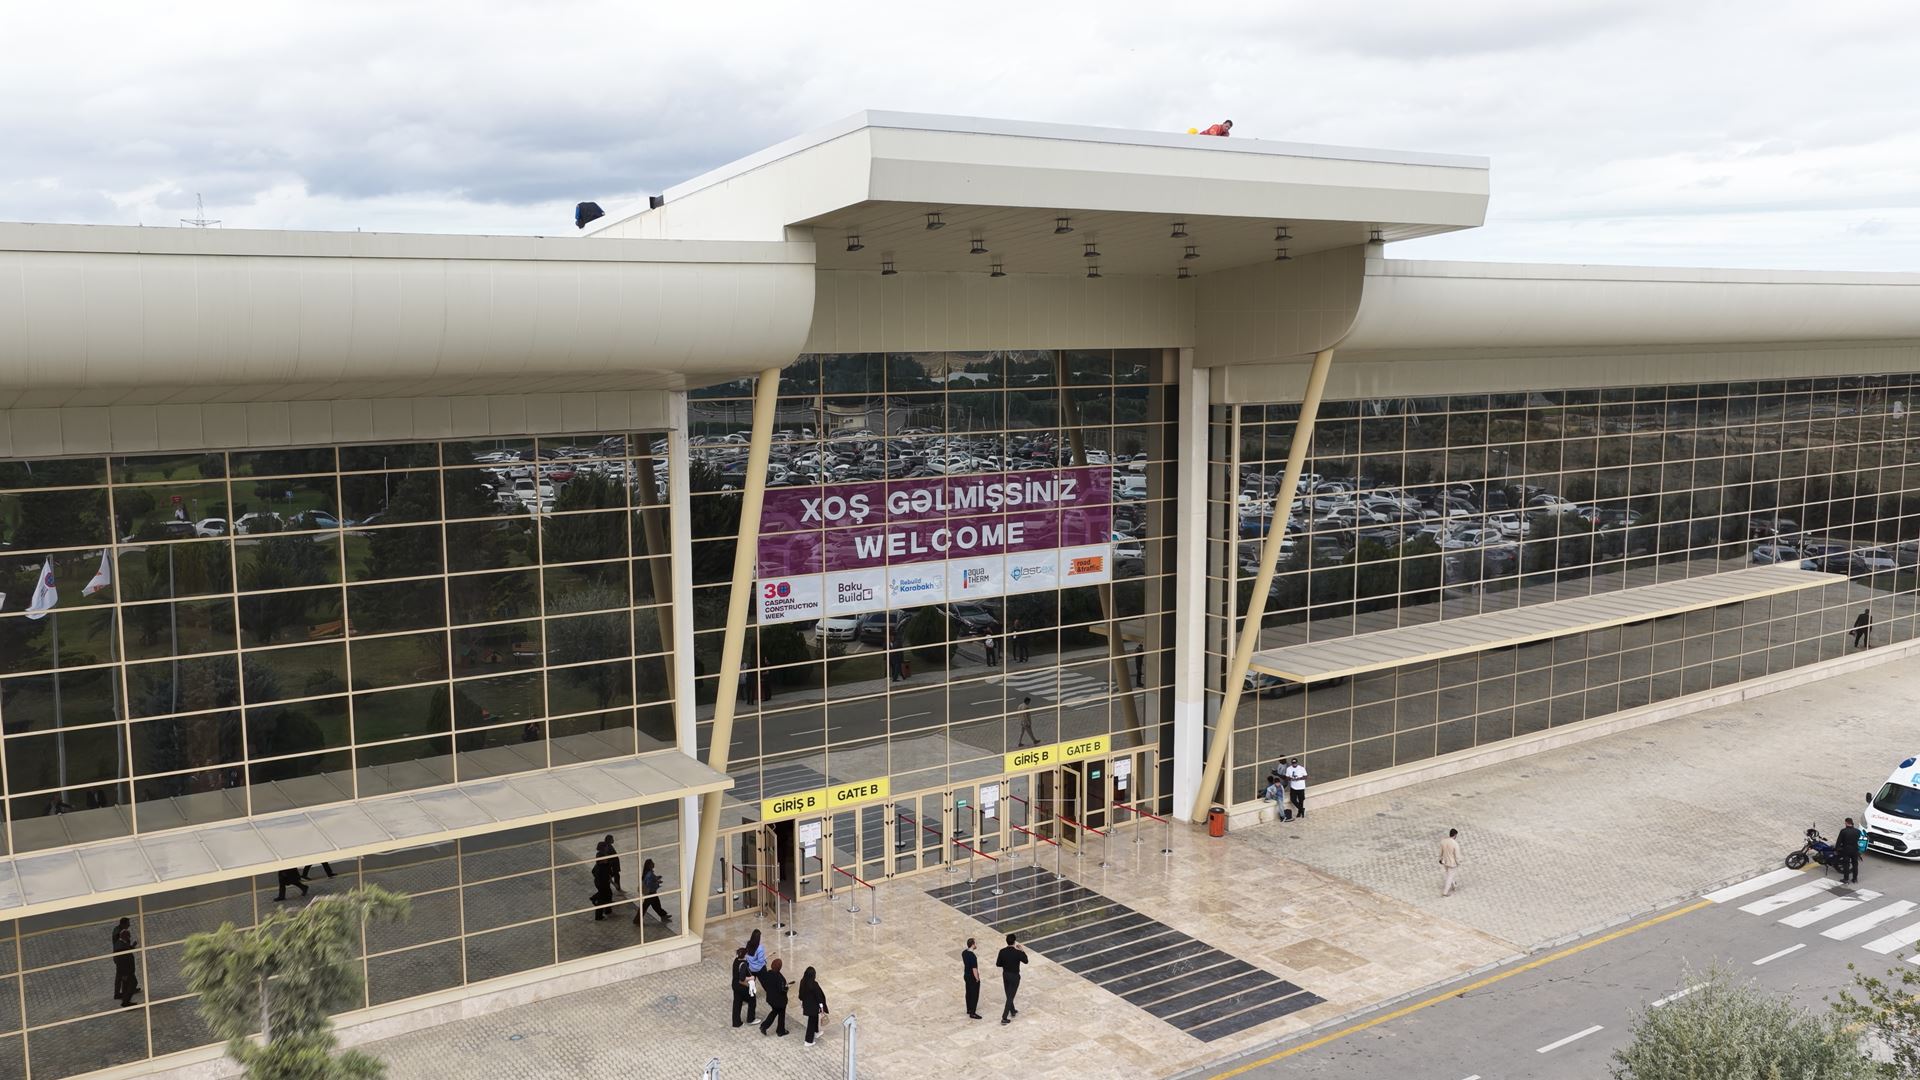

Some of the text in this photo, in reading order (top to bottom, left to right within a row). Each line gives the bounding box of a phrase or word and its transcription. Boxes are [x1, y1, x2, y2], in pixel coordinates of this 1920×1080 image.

[800, 474, 1077, 525] XOŞ GƏLMİŞSİNİZ
[854, 522, 1025, 560] WELCOME
[967, 567, 985, 578] aqua
[968, 575, 990, 584] THERM
[837, 581, 863, 593] Baku
[764, 597, 795, 607] CASPIAN
[838, 592, 863, 604] Build
[764, 601, 819, 614] CONSTRUCTION
[765, 612, 785, 620] WEEK
[1066, 741, 1101, 756] GATE B
[1013, 751, 1049, 766] GİRİŞ B
[837, 784, 879, 801] GATE B
[773, 796, 816, 814] GİRİŞ B
